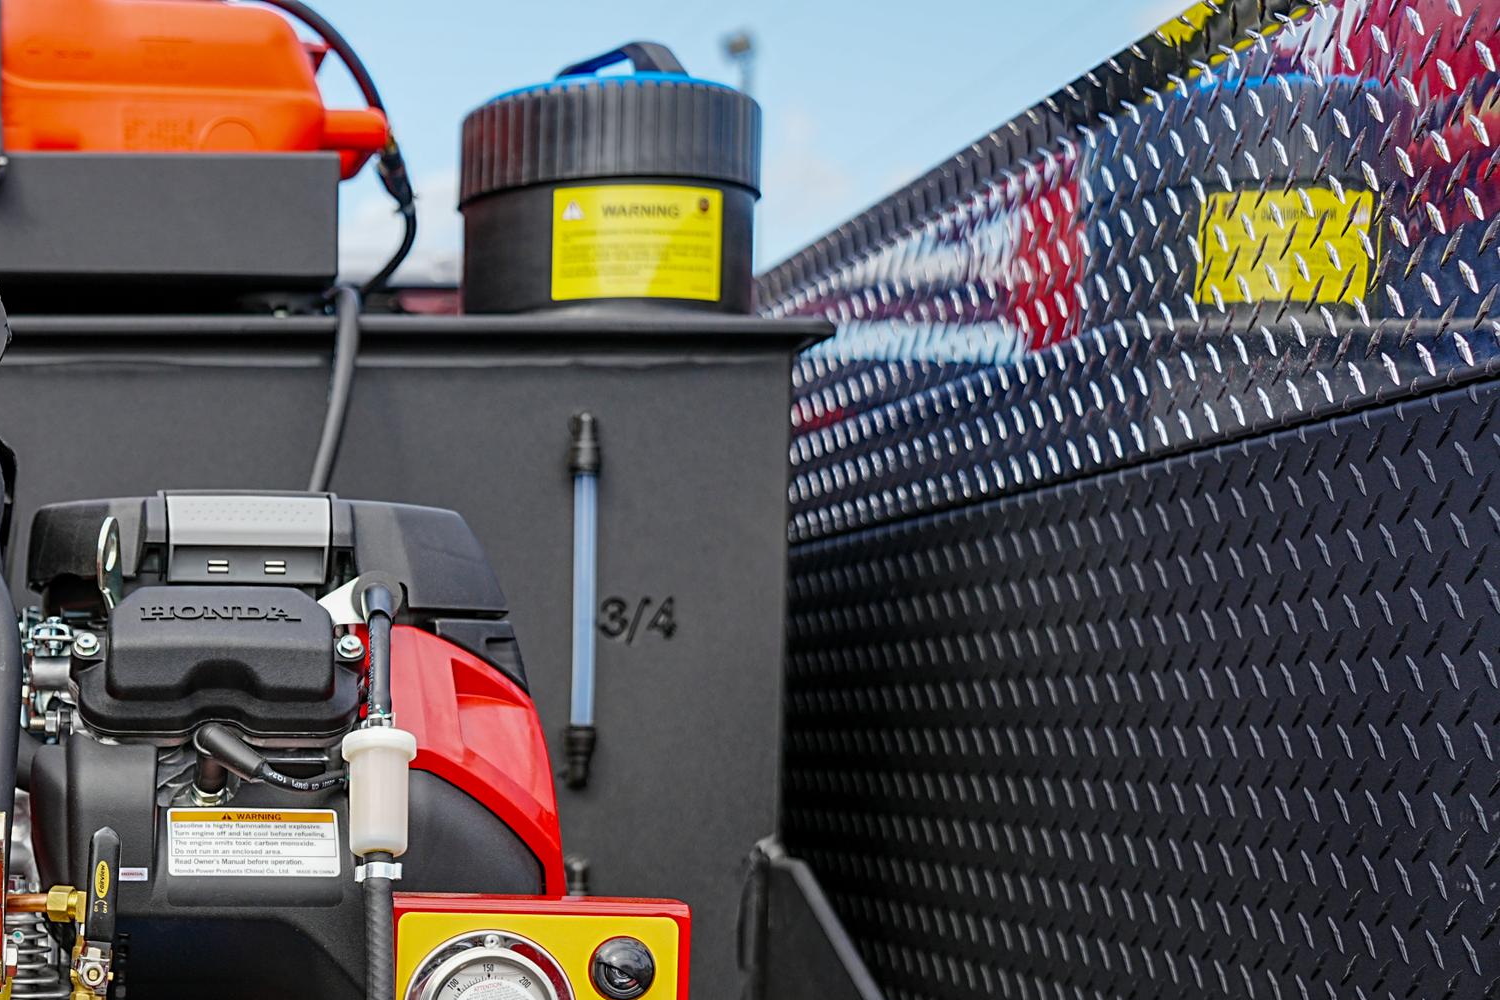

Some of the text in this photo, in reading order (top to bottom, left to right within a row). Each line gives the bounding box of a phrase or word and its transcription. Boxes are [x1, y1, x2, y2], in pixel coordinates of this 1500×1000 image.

[601, 204, 680, 218] WARNING
[139, 606, 302, 622] HONDA
[599, 596, 678, 647] 3/4
[236, 813, 282, 821] WARNING
[483, 964, 494, 972] 150
[447, 978, 460, 990] 100
[518, 976, 532, 988] 200
